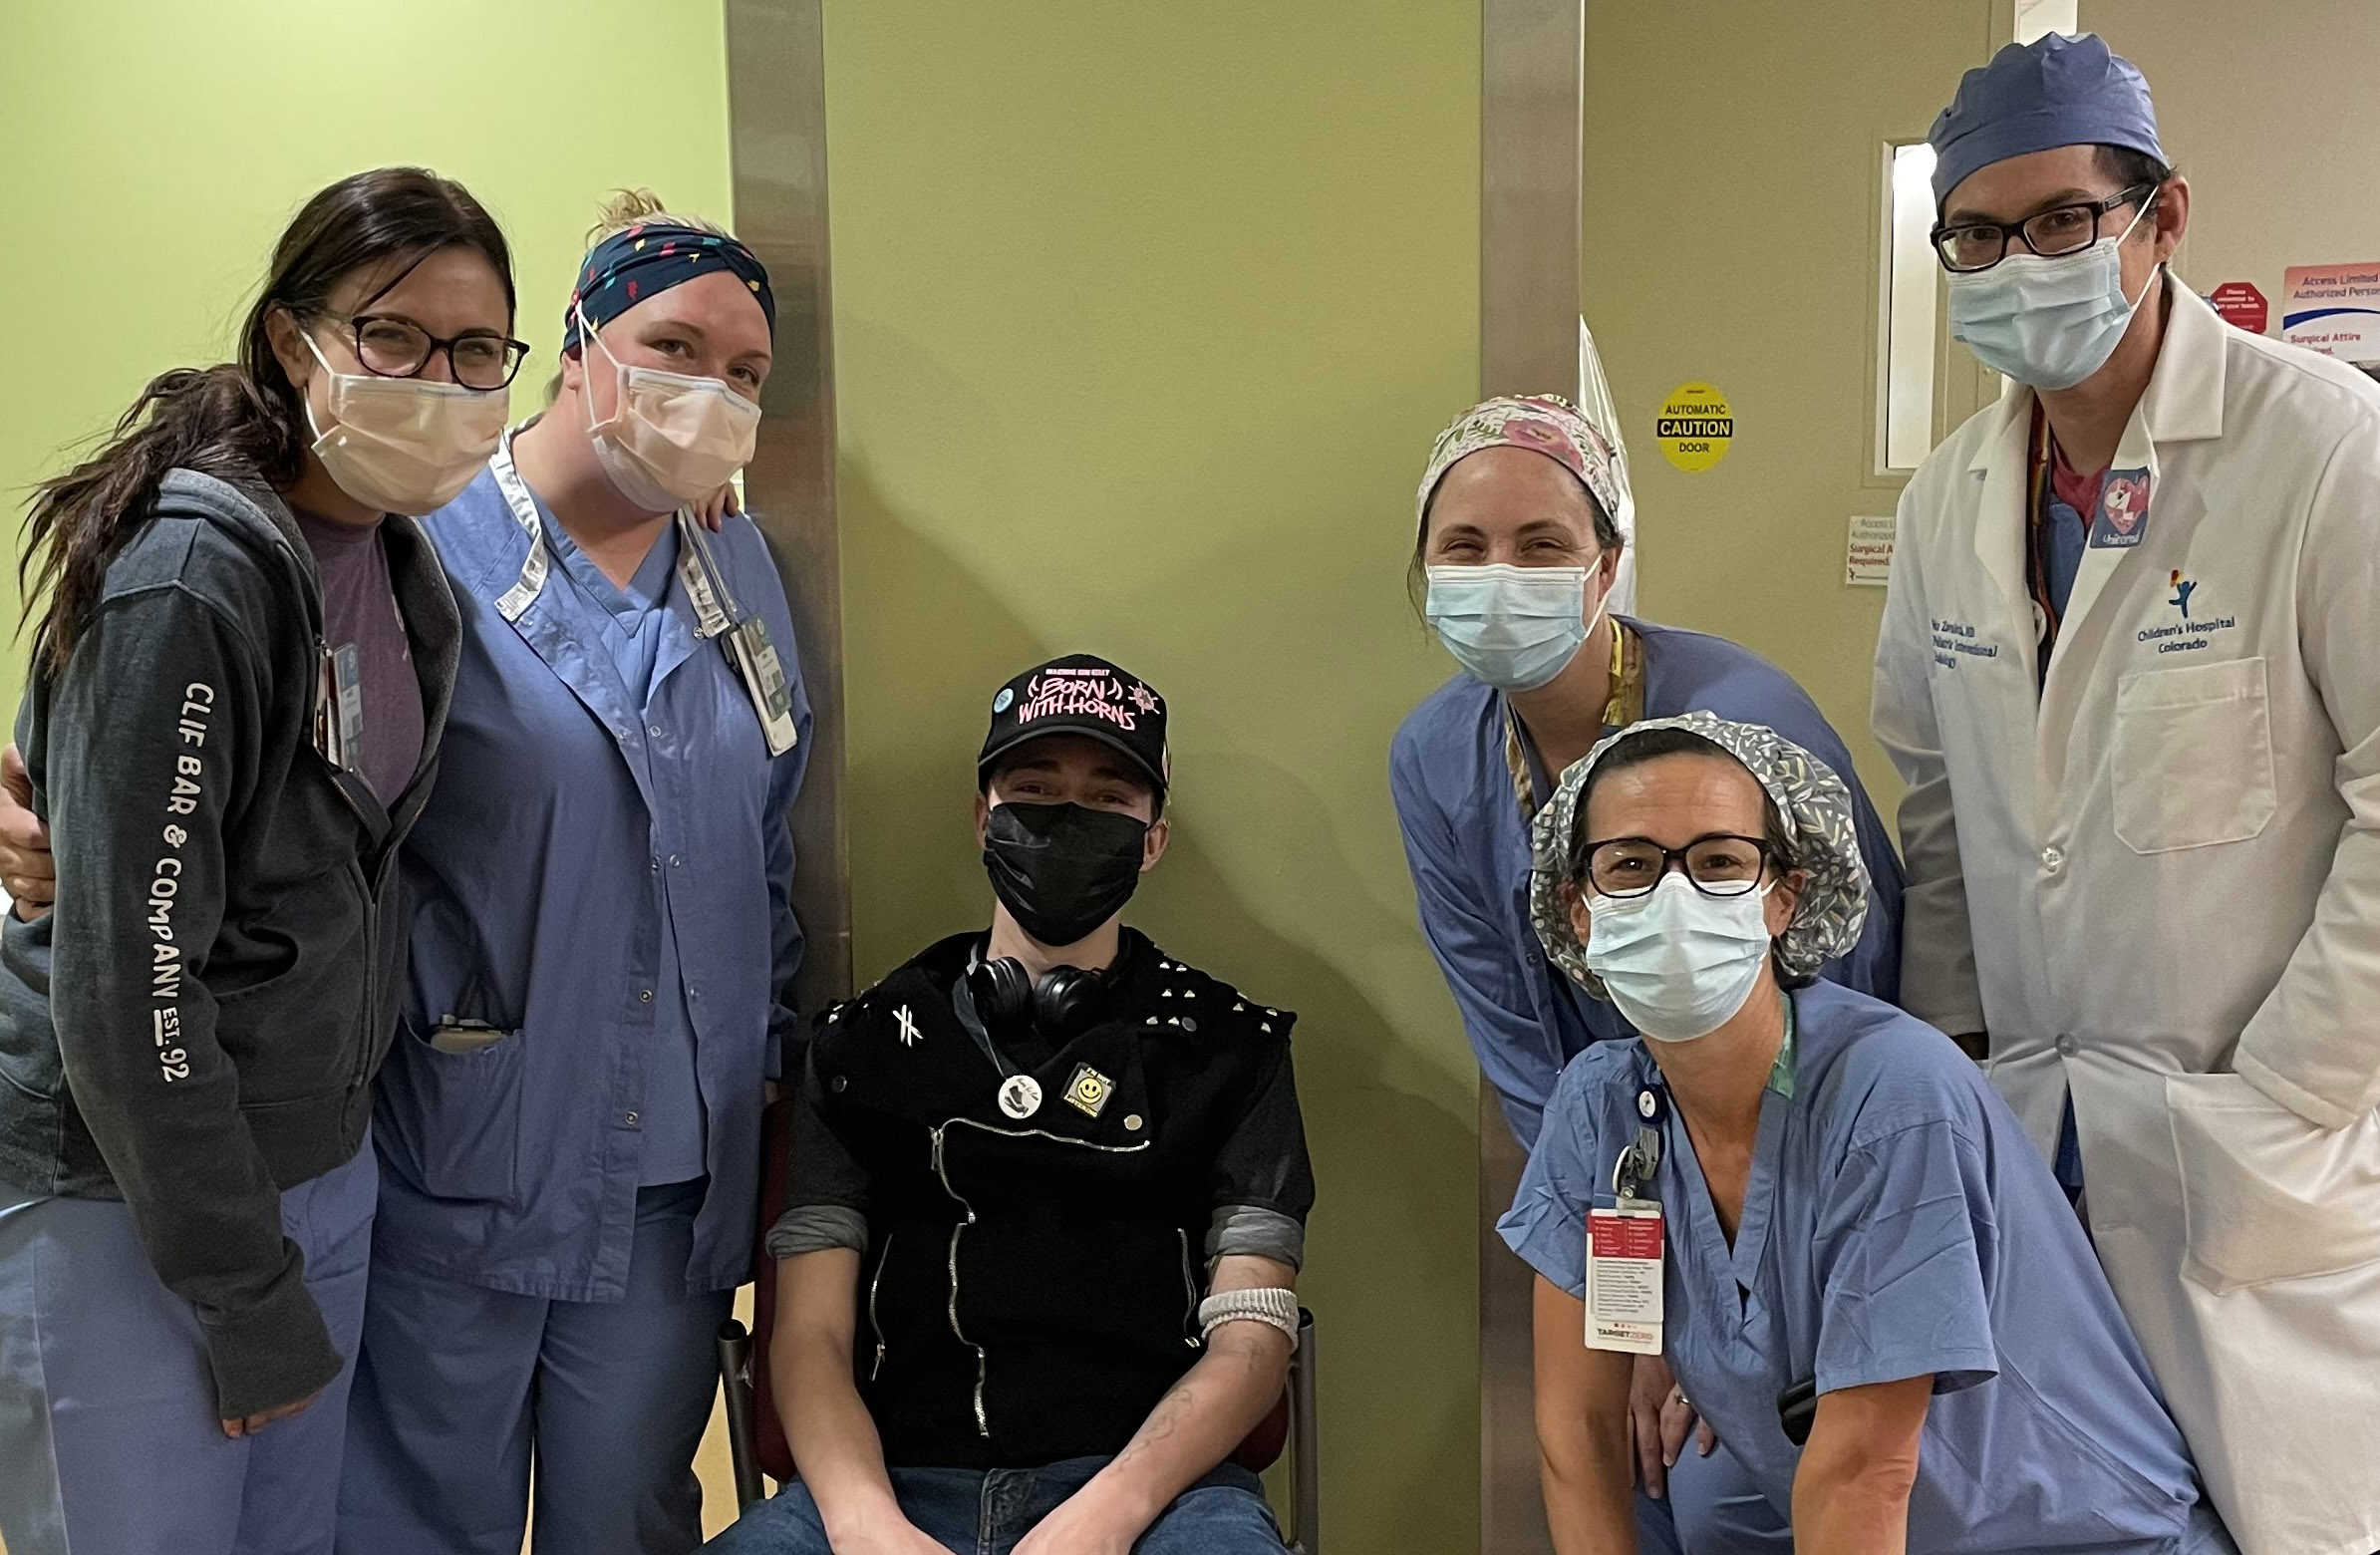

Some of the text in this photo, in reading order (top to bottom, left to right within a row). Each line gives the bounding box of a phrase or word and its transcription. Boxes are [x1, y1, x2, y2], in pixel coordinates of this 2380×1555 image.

[2303, 273, 2379, 286] Access Limited
[2293, 288, 2347, 299] Authorized
[2290, 332, 2361, 344] Surgical Attire
[1665, 405, 1726, 415] AUTOMATIC
[1659, 421, 1731, 436] CAUTION
[1679, 443, 1710, 453] DOOR
[1849, 543, 1886, 555] Surgical
[2137, 615, 2235, 642] Children's Hospital
[2158, 638, 2209, 654] Colorado
[1019, 693, 1136, 731] WITH HORNS
[148, 681, 214, 1083] CLIF BAR & COMPANY EST. 92
